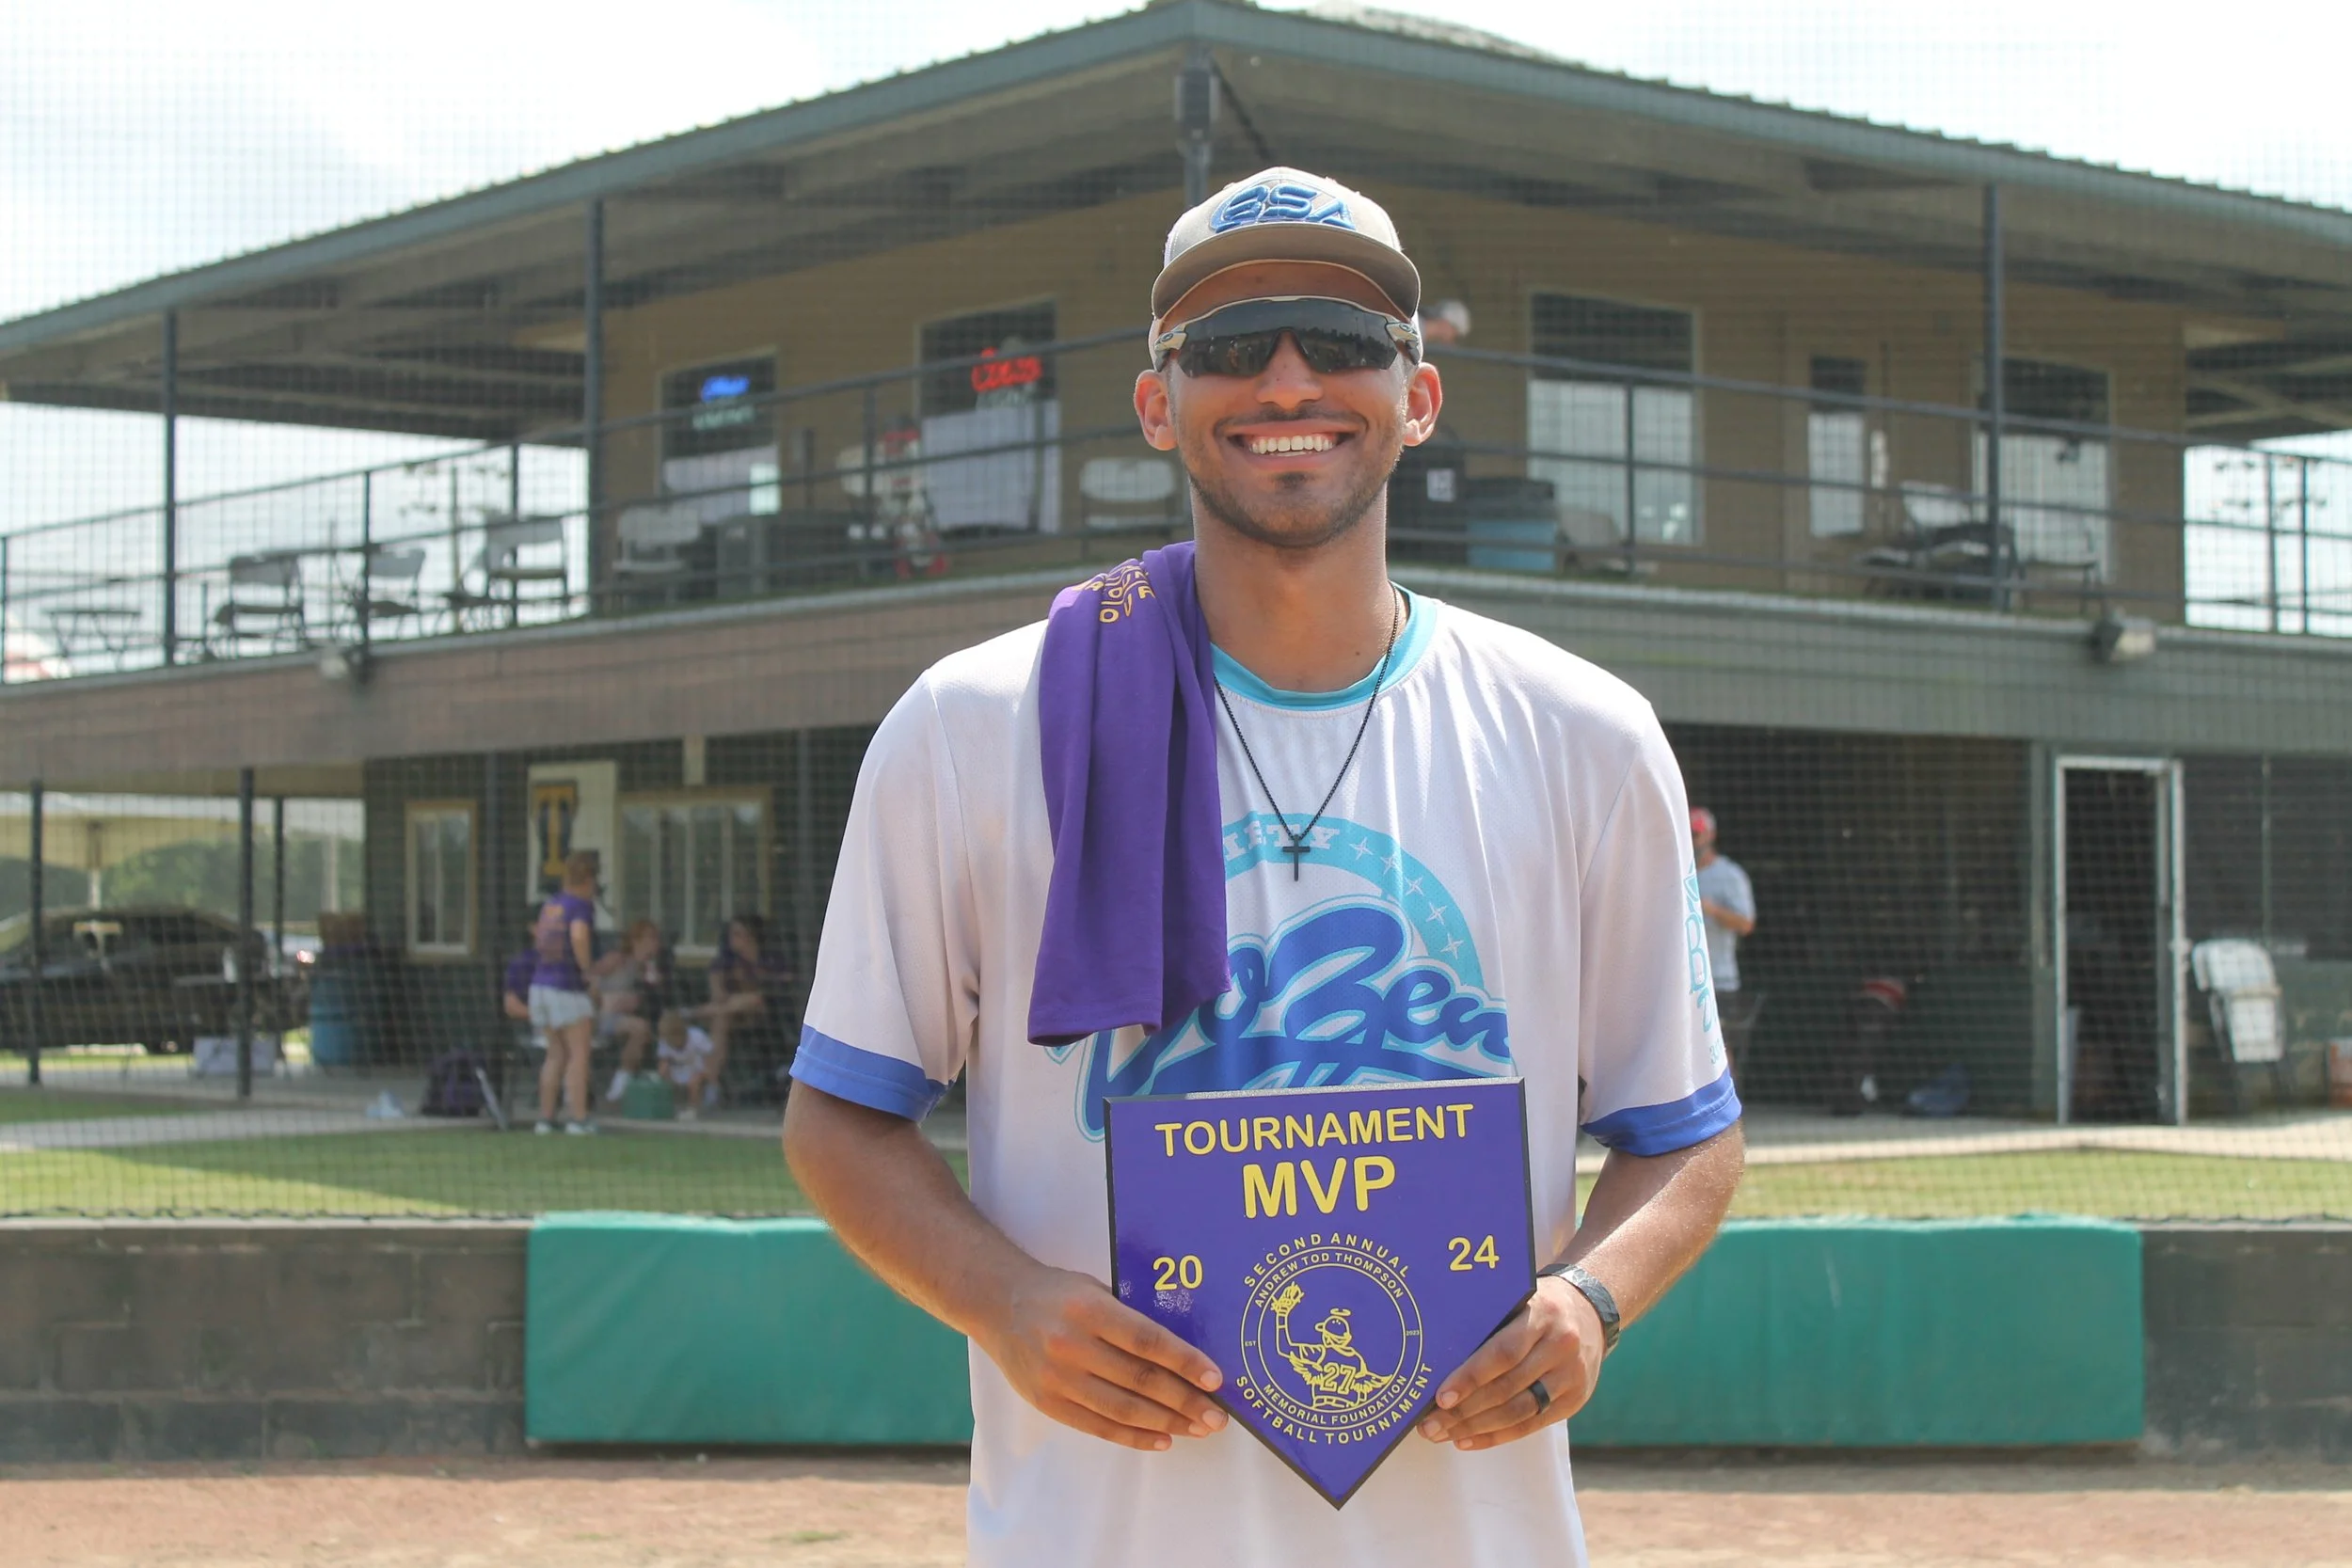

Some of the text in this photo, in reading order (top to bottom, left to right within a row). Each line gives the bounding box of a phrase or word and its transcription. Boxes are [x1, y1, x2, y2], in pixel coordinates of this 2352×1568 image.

[1154, 1102, 1474, 1158] TOURNAMENT
[1243, 1156, 1396, 1219] MVP
[1152, 1255, 1204, 1291] 20
[1244, 1232, 1409, 1288] SECOND ANNUAL
[1254, 1252, 1404, 1307] ANDREW TOD THOMPSON
[1447, 1235, 1500, 1272] 24
[1236, 1362, 1433, 1445] SOFTBALL TOURNAMENT
[1263, 1374, 1407, 1425] MEMORIAL FOUNDATION
[1320, 1362, 1357, 1396] 27
